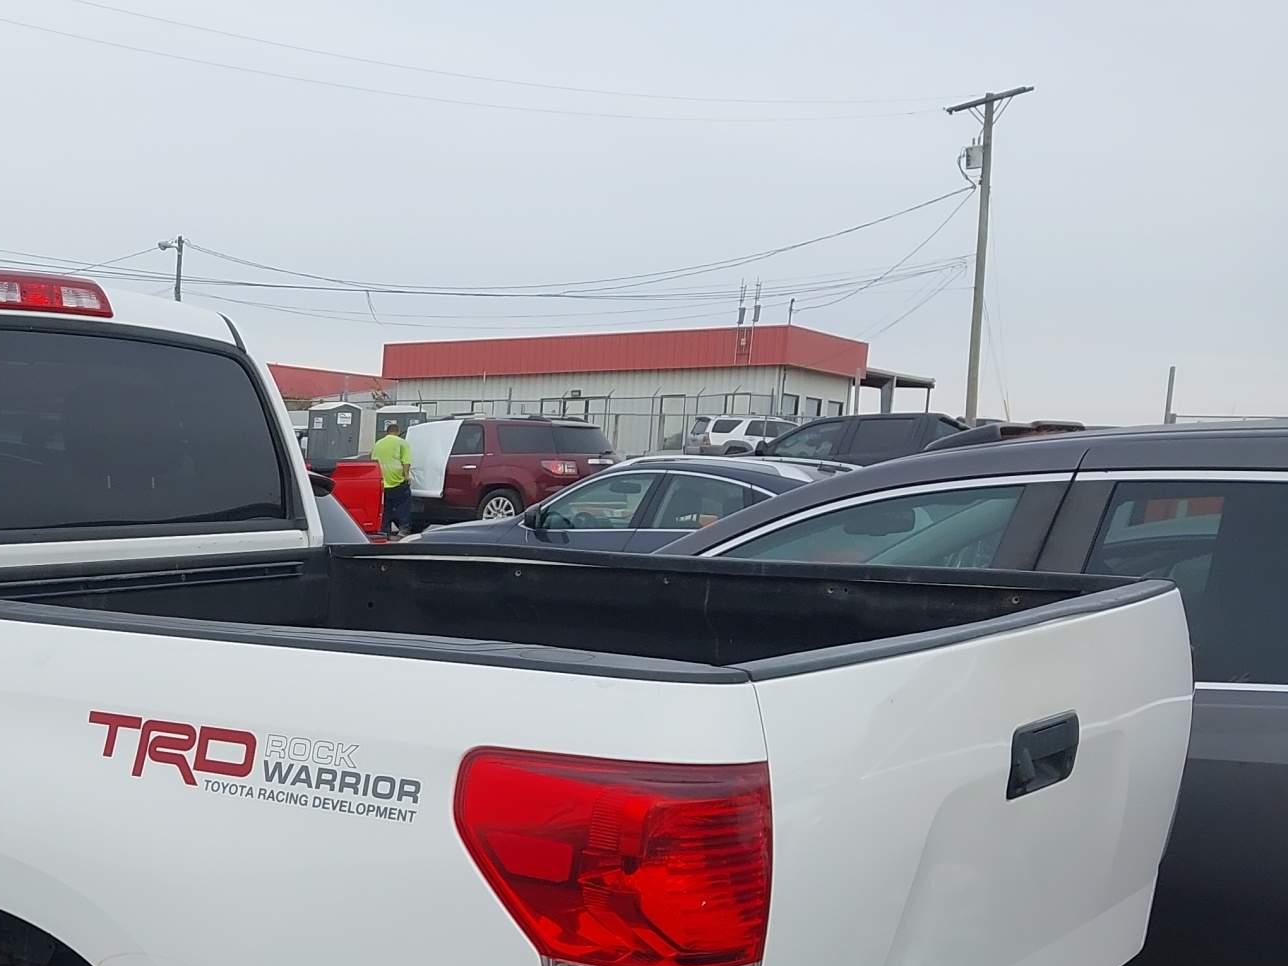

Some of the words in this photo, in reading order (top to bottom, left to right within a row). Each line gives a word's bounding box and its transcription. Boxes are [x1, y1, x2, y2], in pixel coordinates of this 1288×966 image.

[88, 710, 257, 787] TRD
[264, 734, 360, 769] ROCK
[203, 779, 254, 800] TOYOTA
[257, 787, 309, 808] RACING
[312, 795, 418, 824] DEVELOPMENT
[263, 760, 422, 804] WARRIOR
